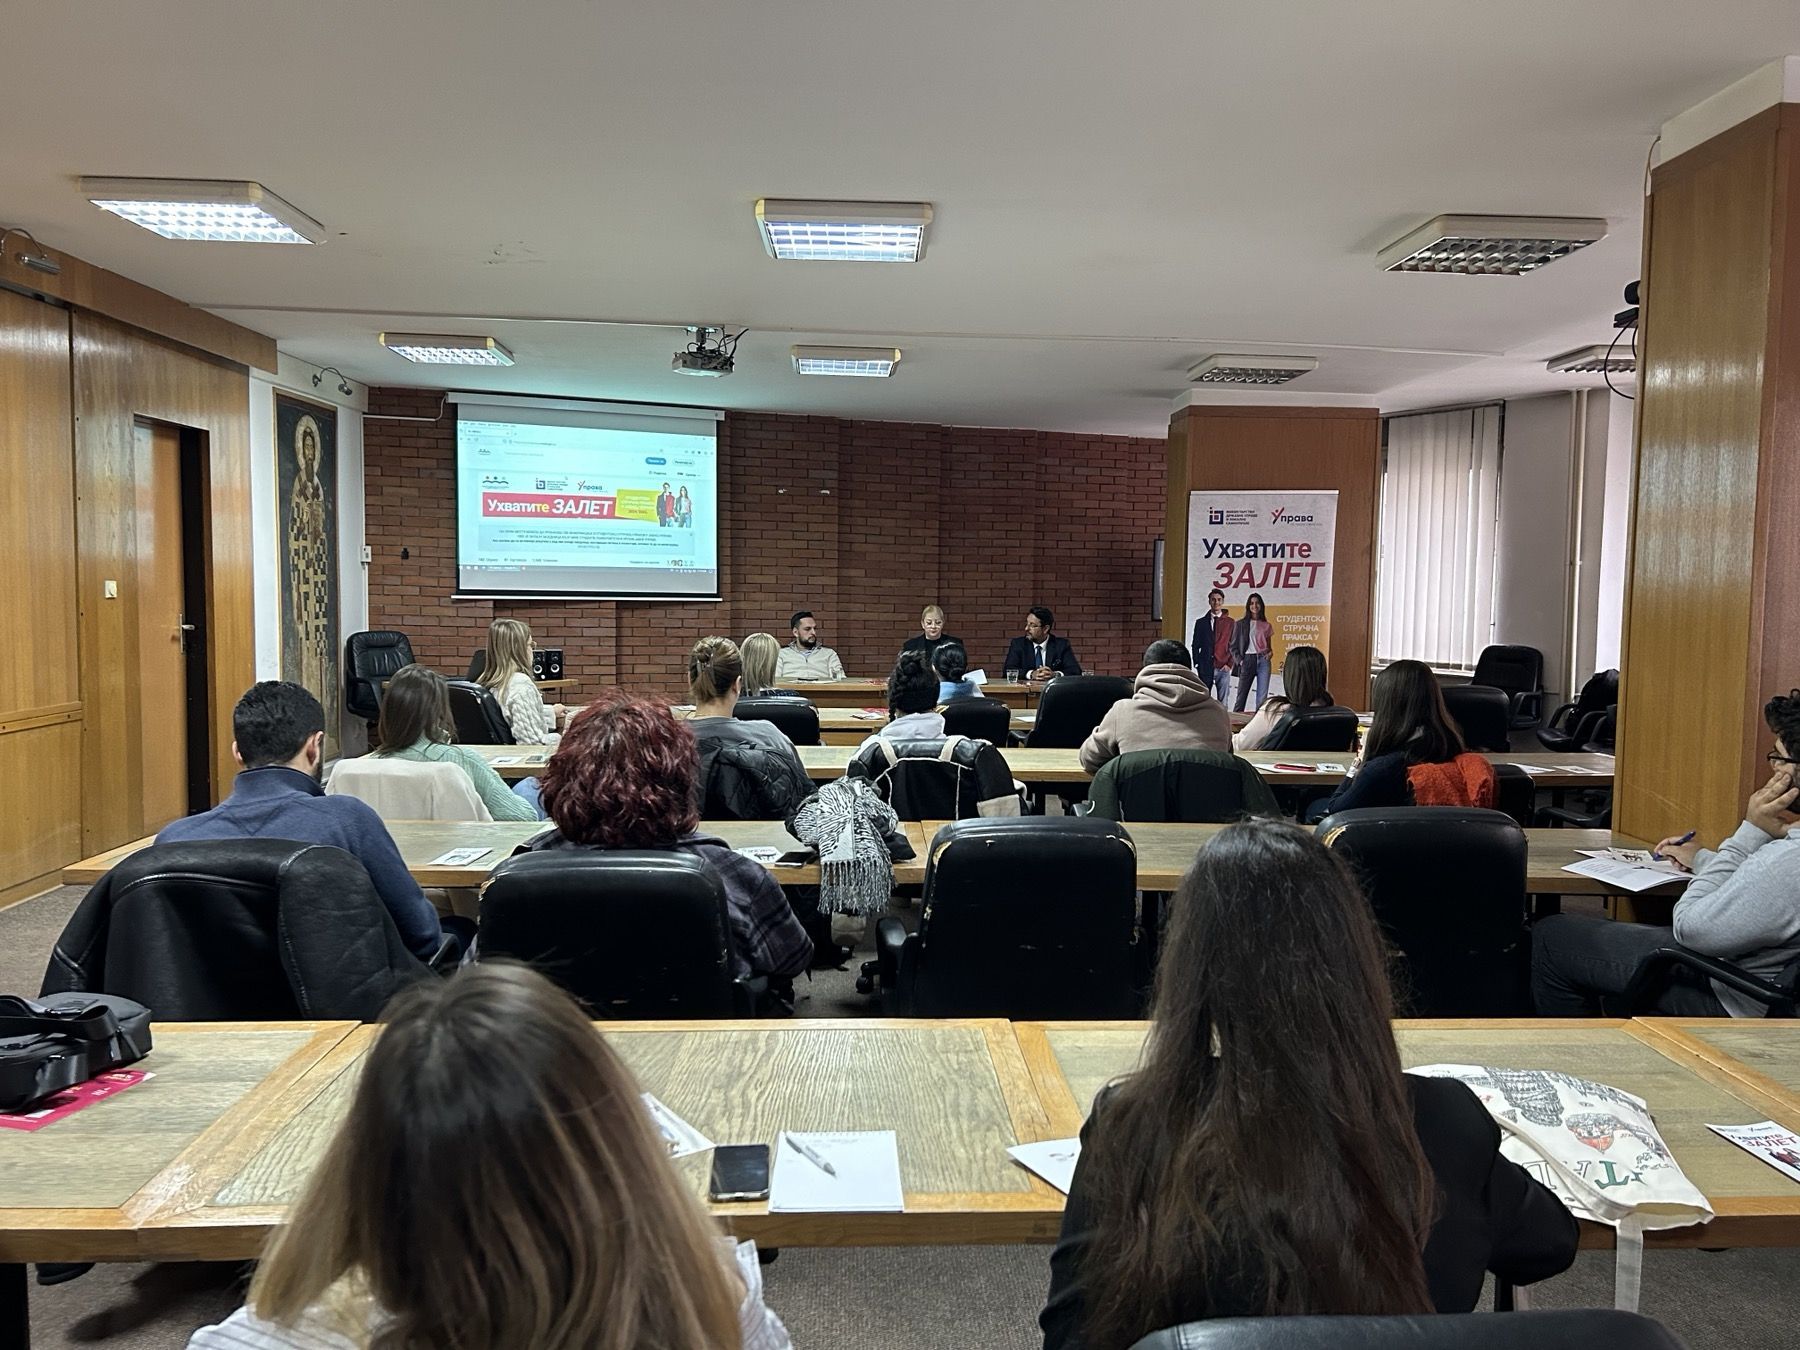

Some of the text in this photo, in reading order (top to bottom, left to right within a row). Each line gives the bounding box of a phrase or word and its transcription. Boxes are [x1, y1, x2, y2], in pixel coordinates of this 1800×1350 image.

[487, 499, 550, 513] Ухватите
[552, 498, 613, 516] ЗАЛЕТ
[1271, 507, 1313, 525] Управа
[1202, 538, 1312, 559] Ухватите
[1213, 562, 1325, 589] ЗАЛЕТ
[1276, 615, 1326, 623] СТУДЕНТСКА
[1282, 624, 1320, 632] СТРУЧНА
[1281, 633, 1320, 641] ПРАКСА У
[1745, 1136, 1798, 1147] ЗАЛЕТ
